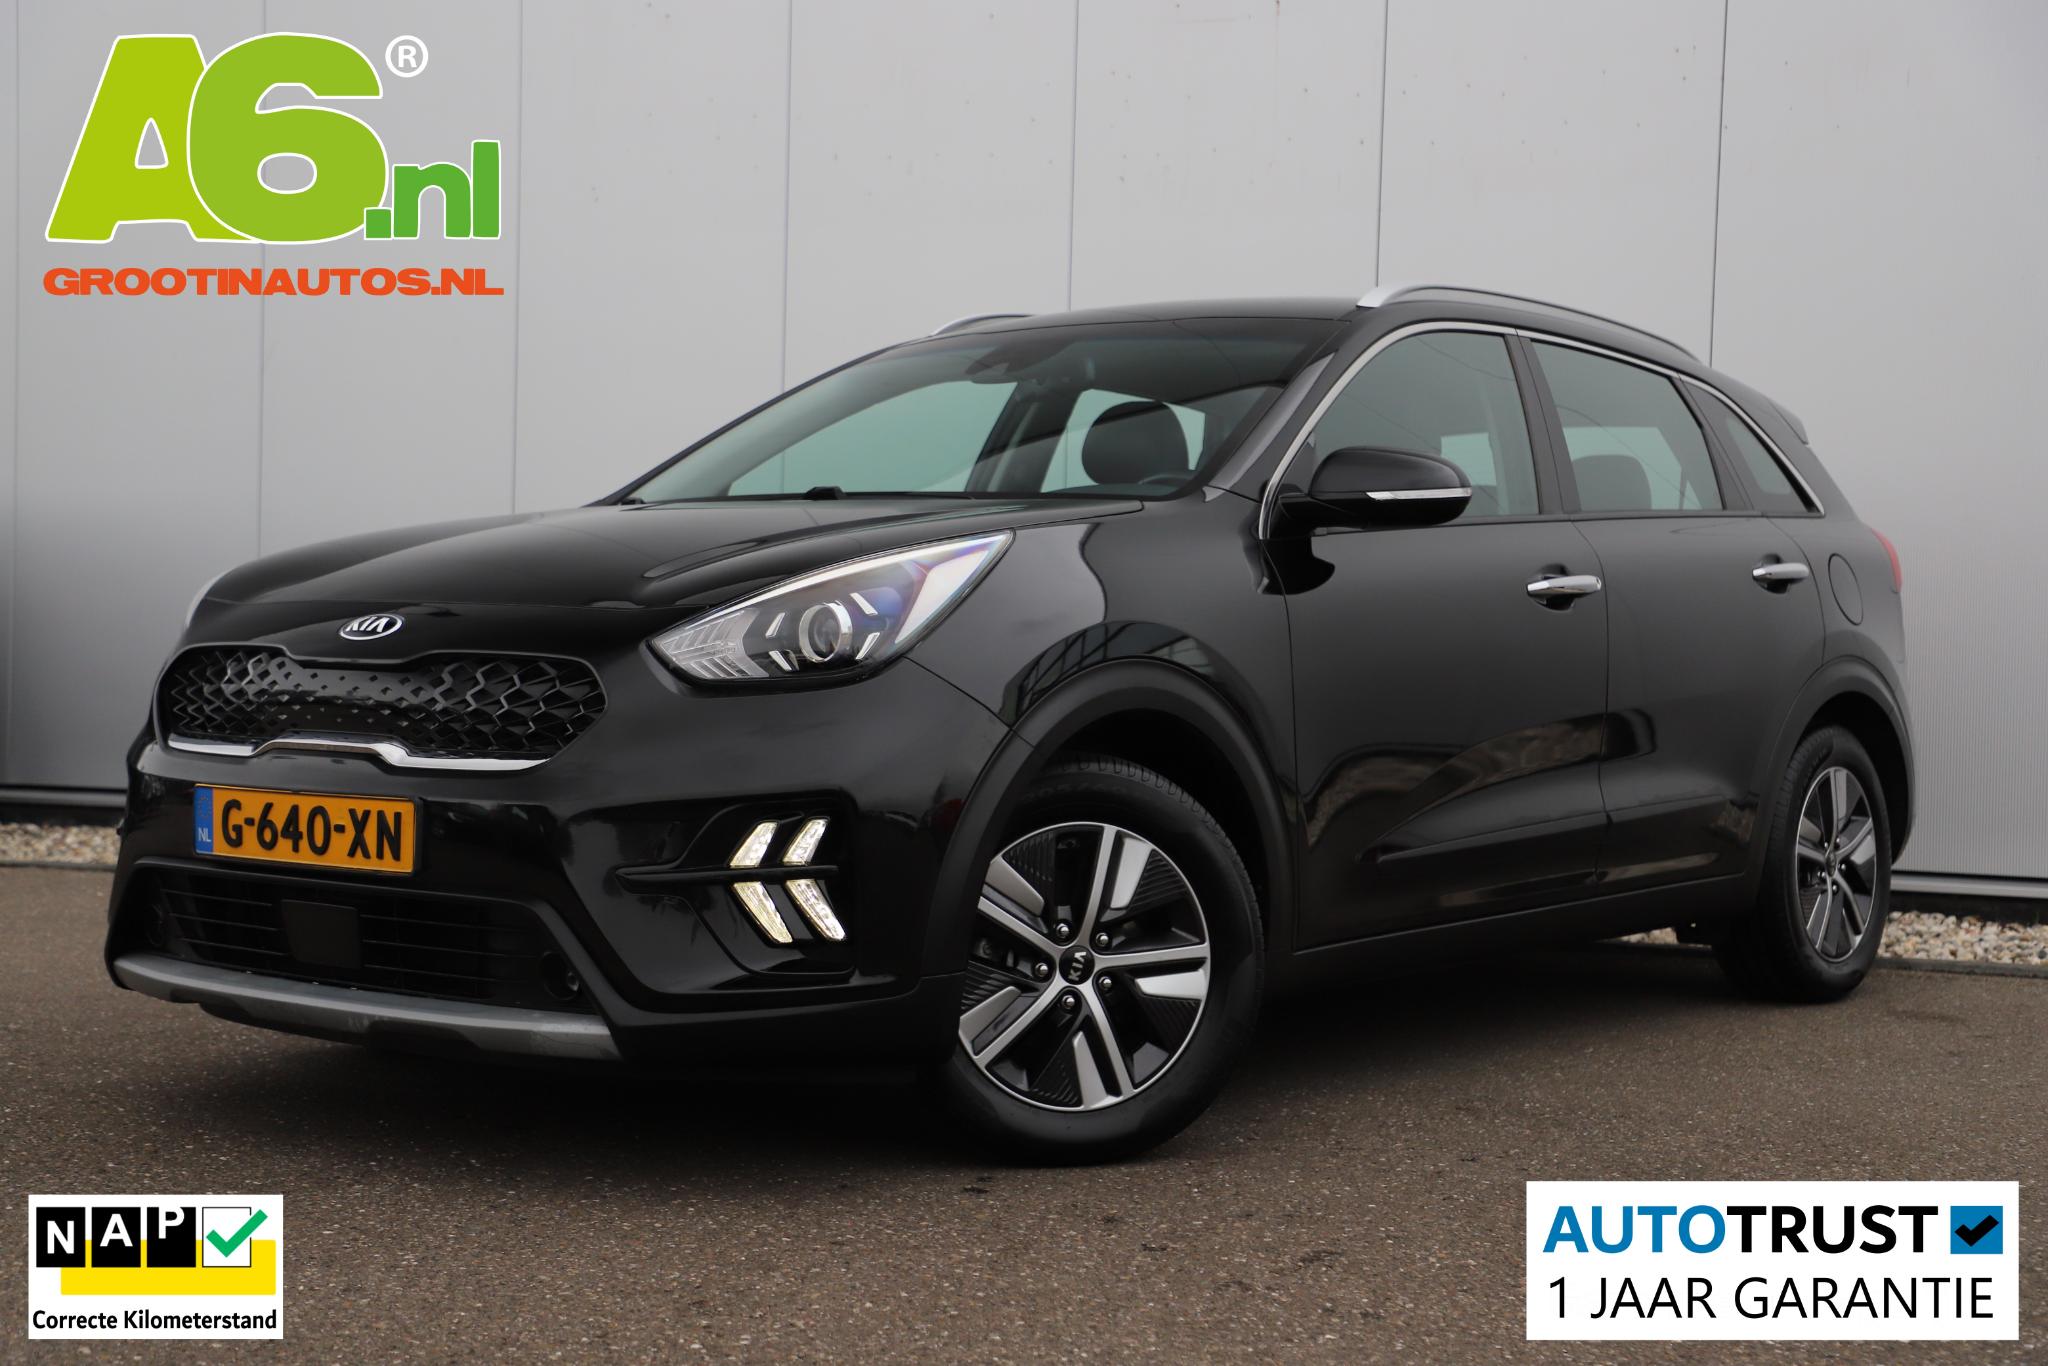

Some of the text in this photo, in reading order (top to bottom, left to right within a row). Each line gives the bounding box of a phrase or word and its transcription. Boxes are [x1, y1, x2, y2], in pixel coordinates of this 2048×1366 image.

[345, 616, 390, 632] KIA
[198, 827, 212, 843] NL
[221, 799, 402, 862] G-640-XN
[1067, 951, 1087, 981] KIA
